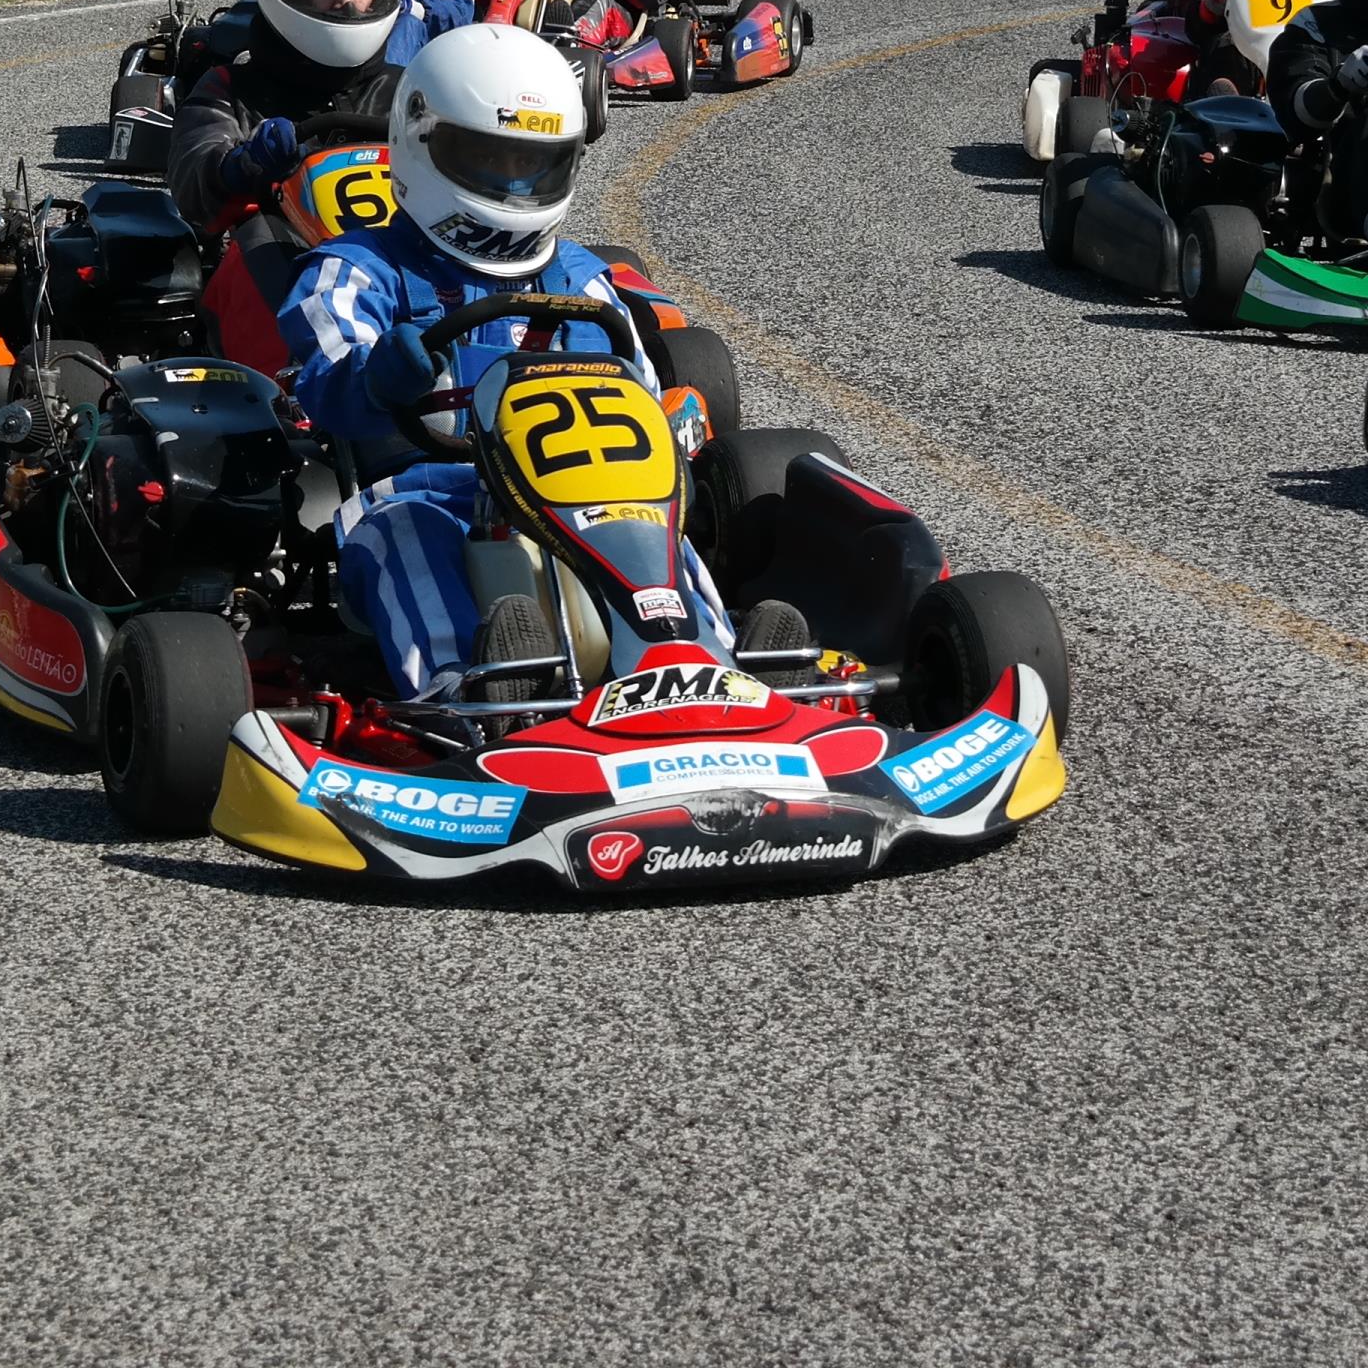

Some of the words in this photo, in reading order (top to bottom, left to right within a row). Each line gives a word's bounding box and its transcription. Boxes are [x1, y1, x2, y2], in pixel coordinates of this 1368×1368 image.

[520, 95, 543, 104] BELL
[526, 114, 562, 135] eni
[334, 170, 391, 226] 6
[525, 362, 622, 376] Maranello
[510, 387, 652, 478] 25
[618, 508, 661, 522] eni
[26, 645, 76, 684] LEITÃO
[653, 753, 771, 773] GRACIO
[910, 718, 1010, 782] BOGE
[948, 772, 970, 787] THE
[966, 762, 985, 778] AIR
[980, 754, 998, 769] TO
[992, 732, 1026, 758] WORK.
[656, 768, 774, 782] COMPRESSORES
[354, 779, 516, 818] BOGE
[382, 810, 408, 824] THE
[409, 816, 436, 829] AIR
[439, 821, 458, 832] TO
[461, 823, 504, 835] WORK.
[643, 845, 729, 875] Talhos
[732, 834, 863, 866] Almerinda
